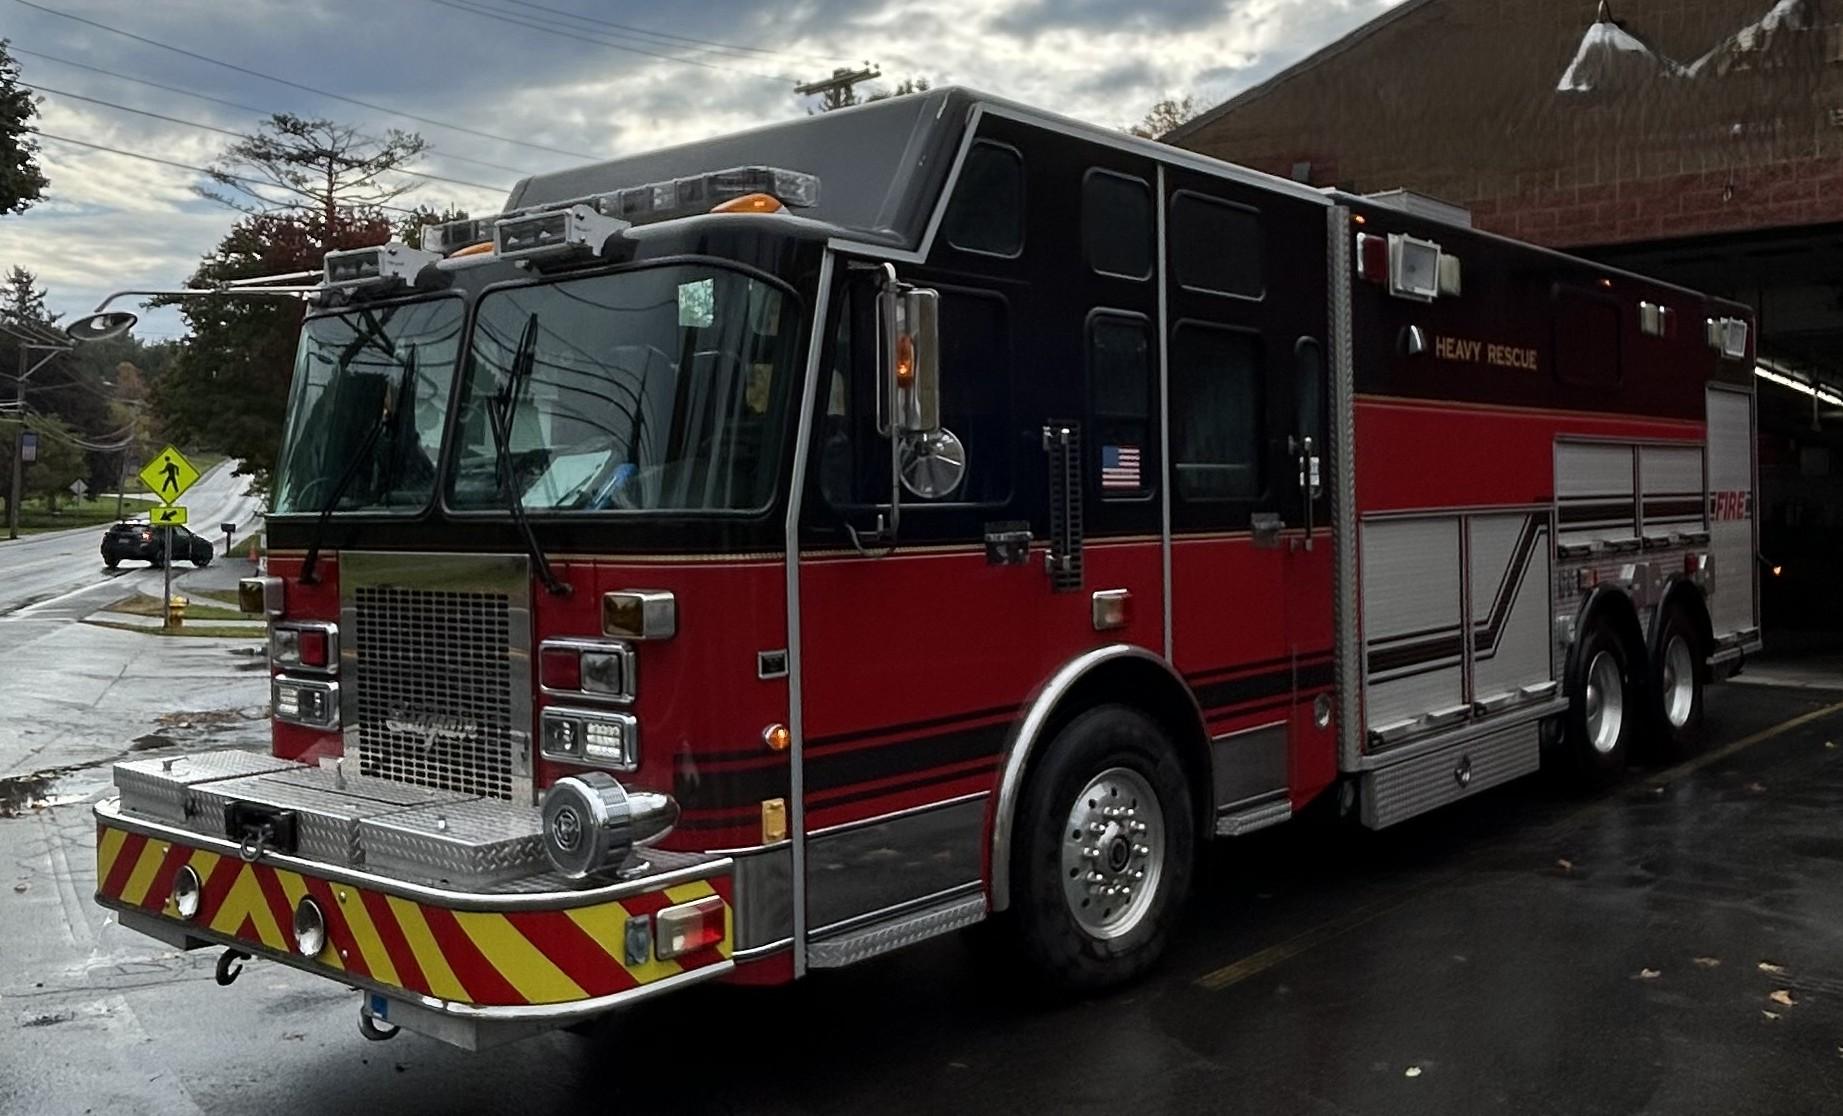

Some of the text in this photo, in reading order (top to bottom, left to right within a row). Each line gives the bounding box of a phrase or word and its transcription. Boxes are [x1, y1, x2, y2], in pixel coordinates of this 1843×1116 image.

[1435, 336, 1537, 370] HEAVY RESCUE
[1715, 490, 1745, 520] FIRE
